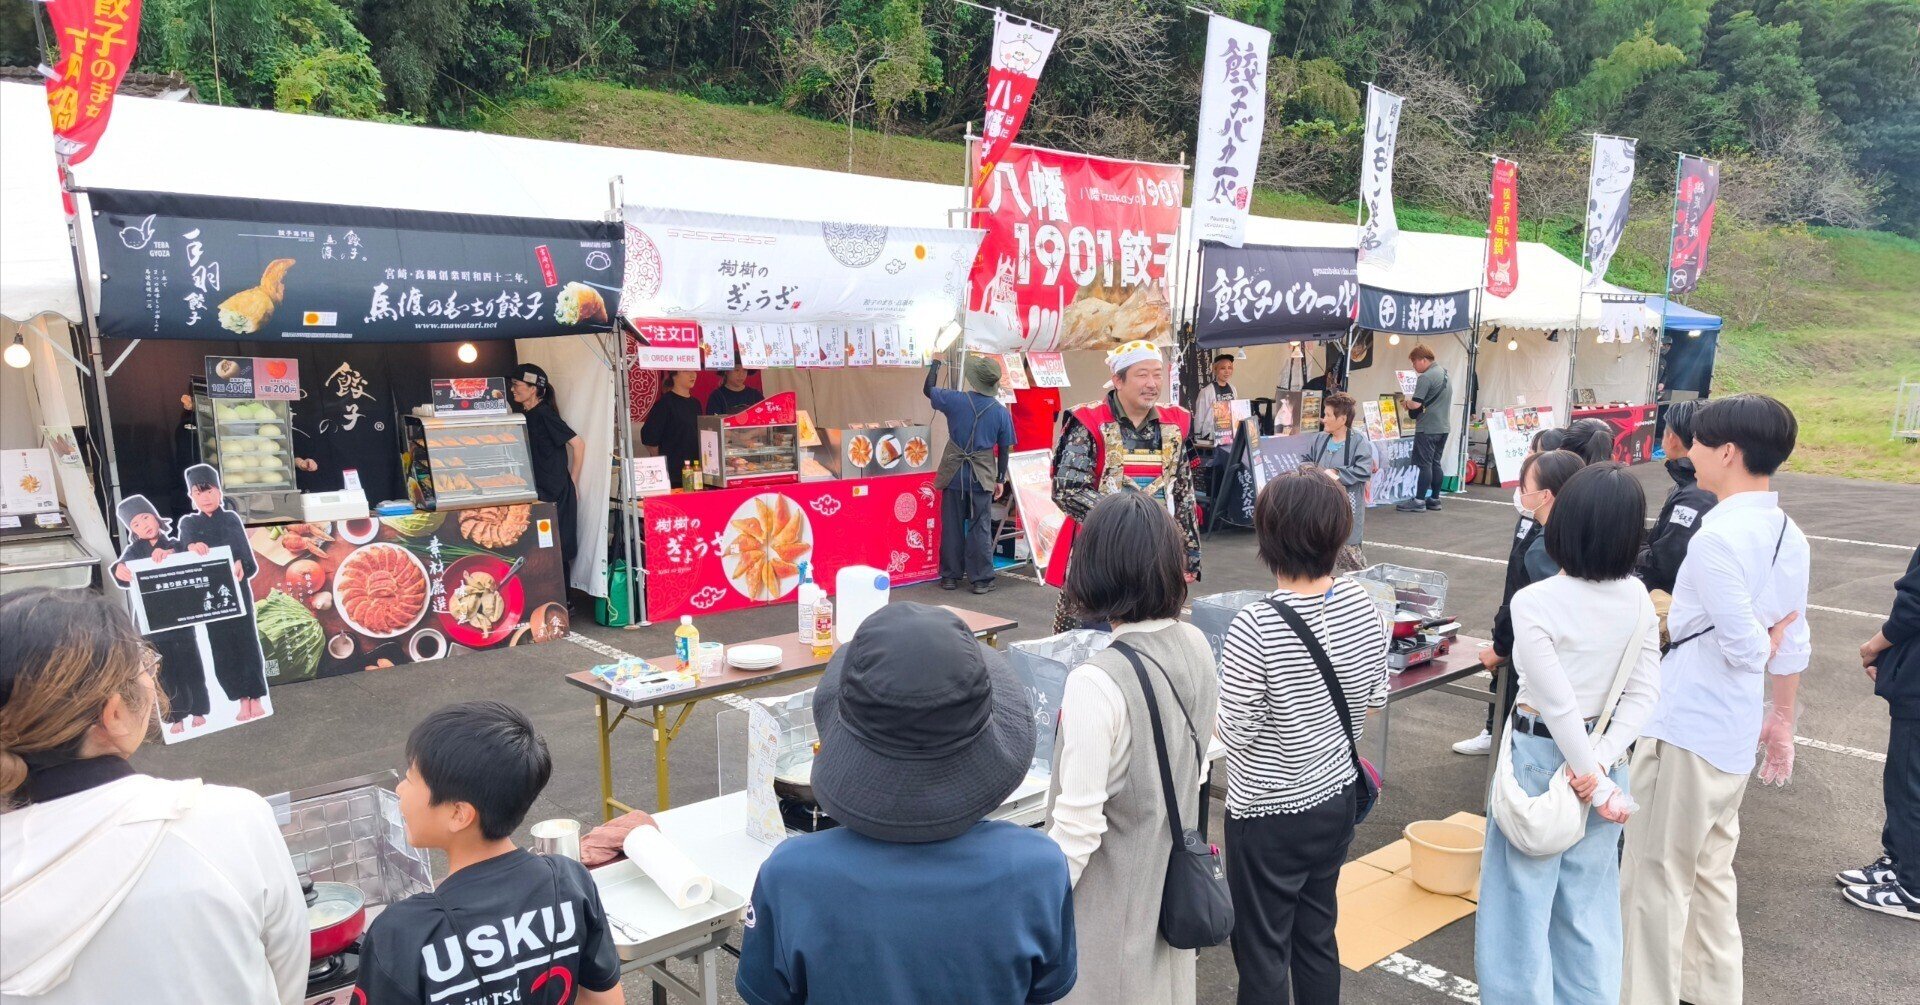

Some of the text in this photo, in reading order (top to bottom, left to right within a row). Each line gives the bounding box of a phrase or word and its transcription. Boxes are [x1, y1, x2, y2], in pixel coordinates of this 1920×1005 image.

[1207, 37, 1261, 207] 餃子バカ一代
[989, 162, 1070, 223] 八幡
[153, 241, 170, 249] TEBA
[717, 259, 769, 279] 樹樹の
[363, 281, 544, 325] 馬渡のもっちり餃子。
[727, 281, 799, 313] ぎょうざ
[1207, 266, 1358, 323] 餃子バカ一代
[414, 322, 498, 330] www.mawatari.net
[651, 354, 696, 363] ORDER HERE
[655, 516, 701, 533] 樹樹の
[421, 900, 577, 983] USKU
